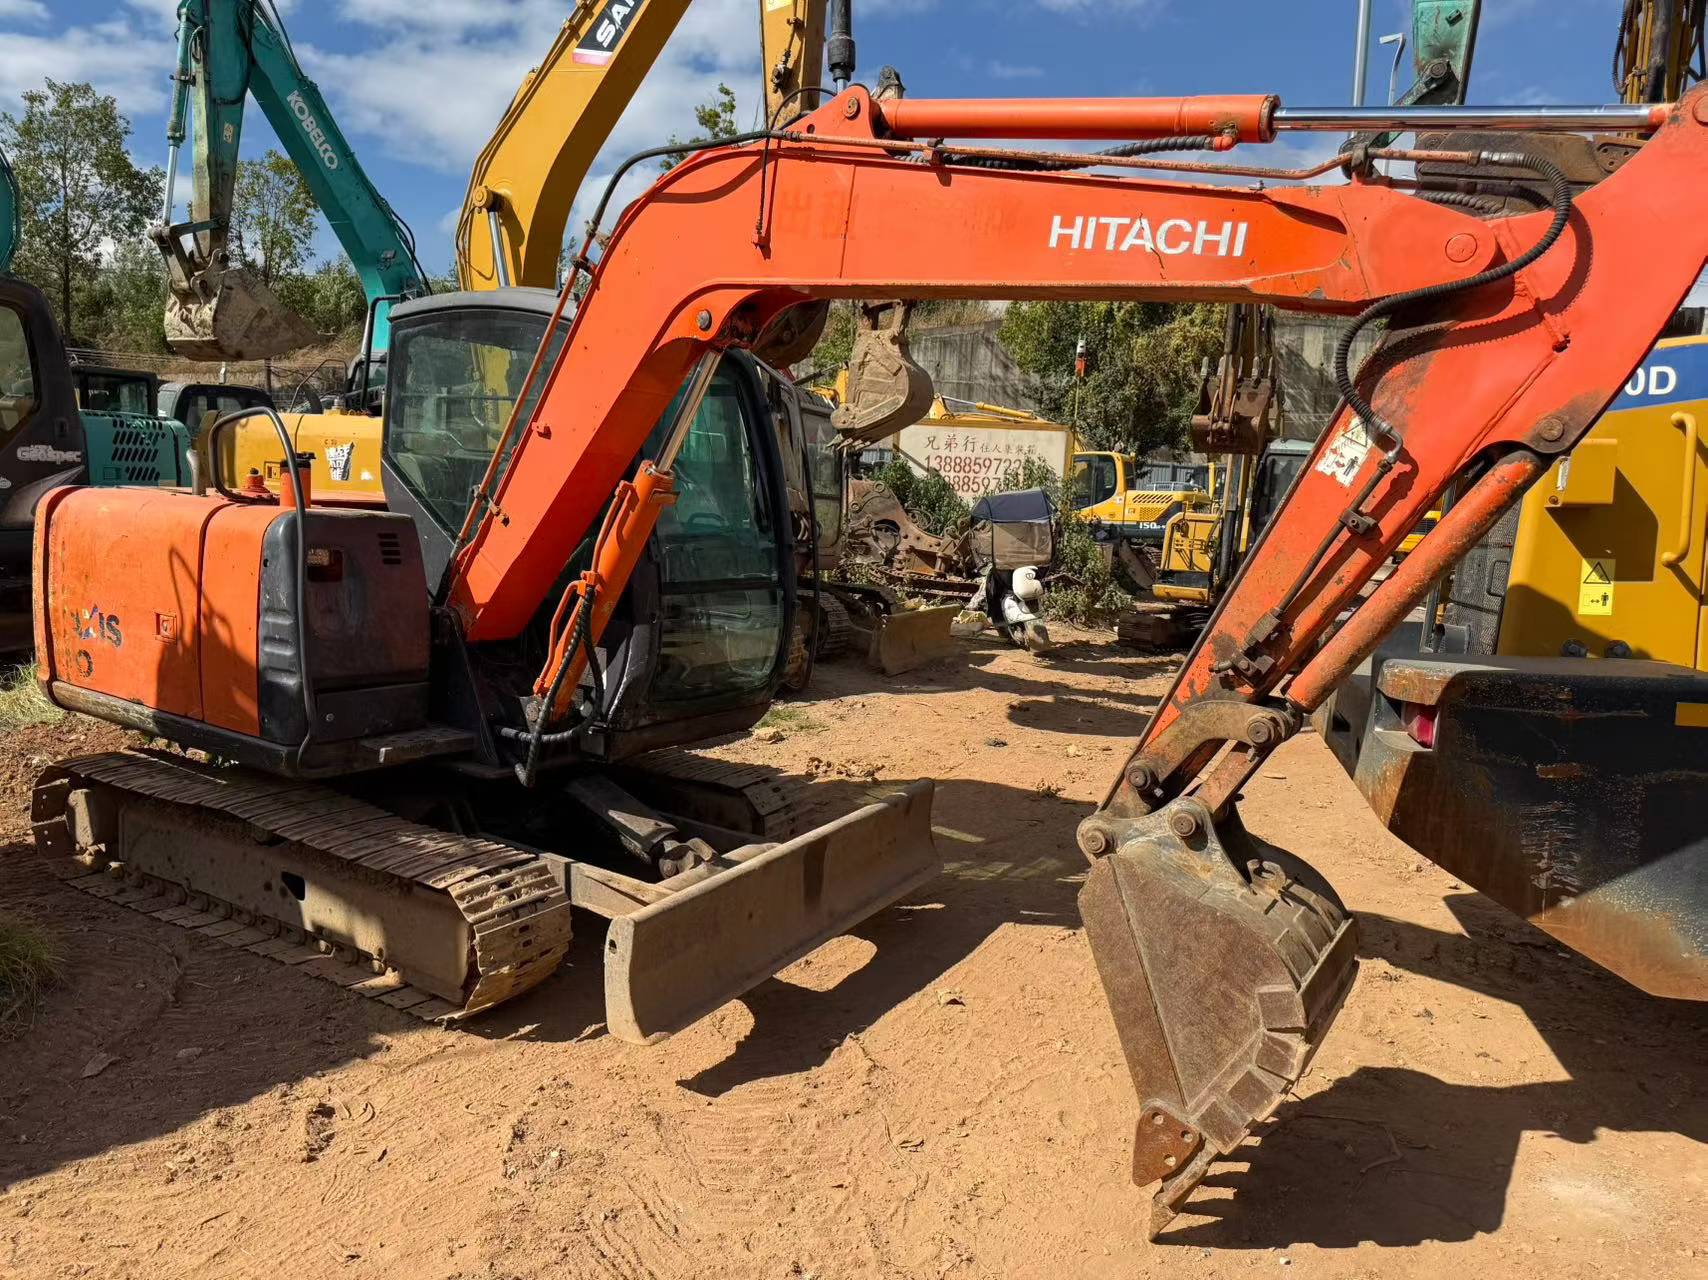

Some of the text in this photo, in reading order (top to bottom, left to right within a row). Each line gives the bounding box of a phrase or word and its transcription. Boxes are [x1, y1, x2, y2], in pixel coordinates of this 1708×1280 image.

[286, 89, 338, 170] KOBELCO
[1048, 215, 1248, 257] HITACHI
[924, 434, 976, 453] 兄弟行
[924, 454, 1023, 476] 1388859722
